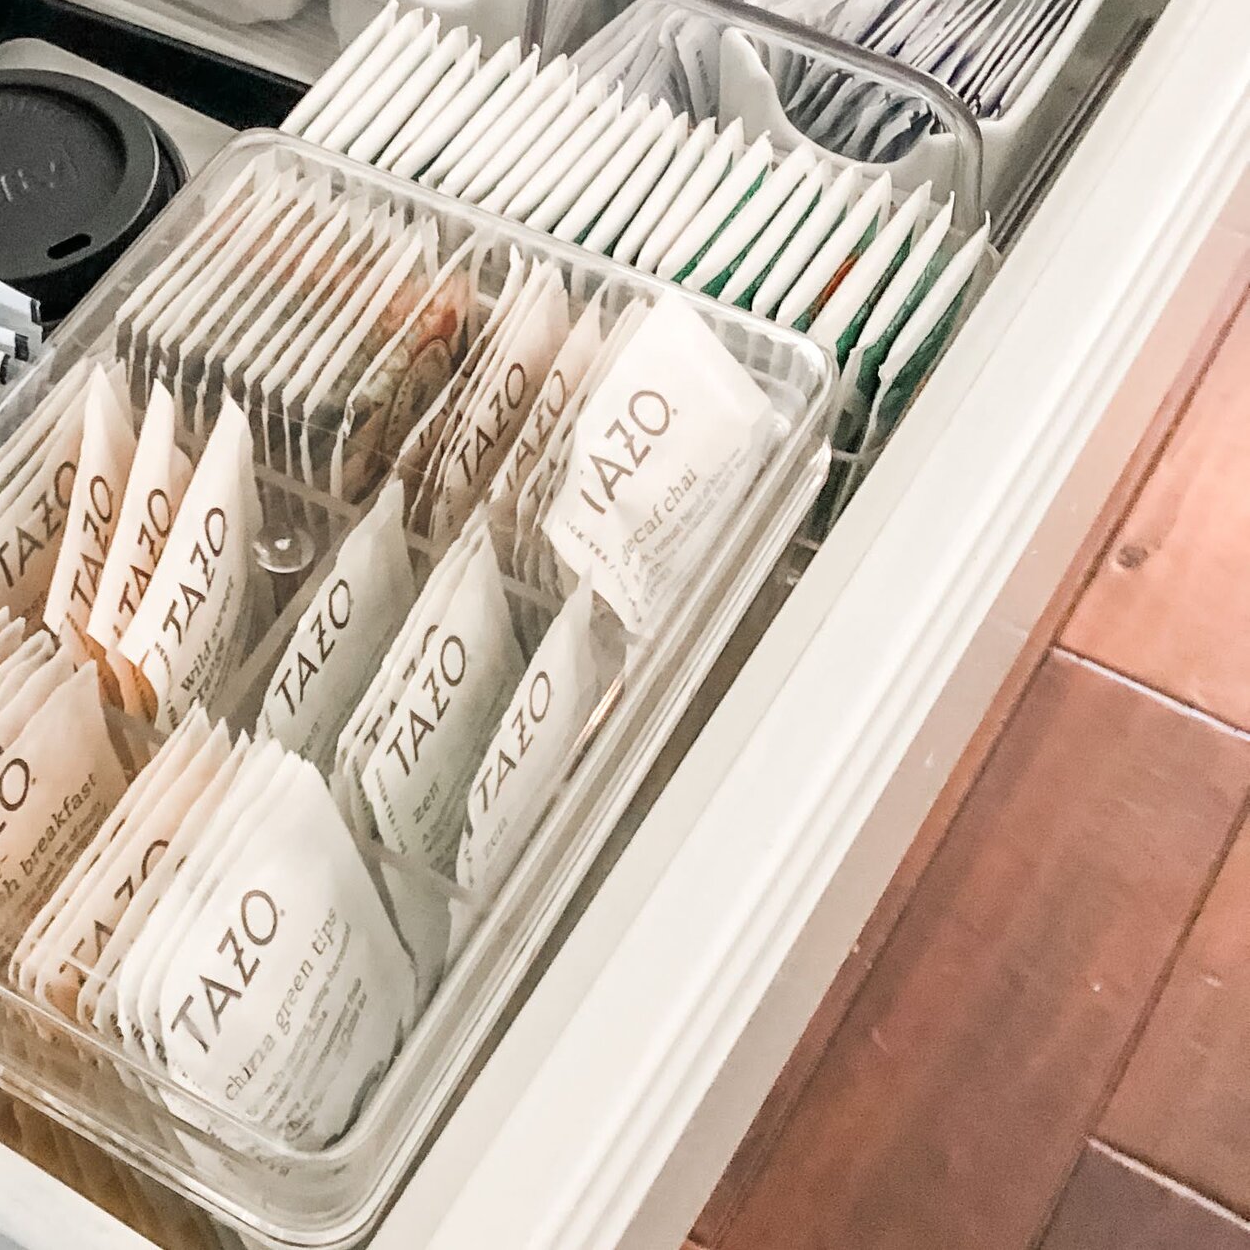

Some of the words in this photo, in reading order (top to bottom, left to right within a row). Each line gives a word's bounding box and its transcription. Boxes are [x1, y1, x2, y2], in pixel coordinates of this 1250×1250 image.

[455, 363, 526, 486] TAZO
[70, 475, 114, 613] TAZO
[118, 488, 172, 617] TAZO
[162, 506, 227, 645] TAZO
[621, 502, 664, 567] decaf
[663, 461, 698, 514] chai
[180, 639, 212, 692] wild
[274, 578, 350, 717] TAZO
[386, 634, 466, 777] TAZO
[411, 781, 440, 825] zen
[474, 670, 551, 813] TAZO
[19, 772, 98, 878] breakfast
[170, 888, 279, 1055] TAZO
[225, 1031, 276, 1102] china
[275, 959, 314, 1036] green
[311, 907, 338, 957] tips
